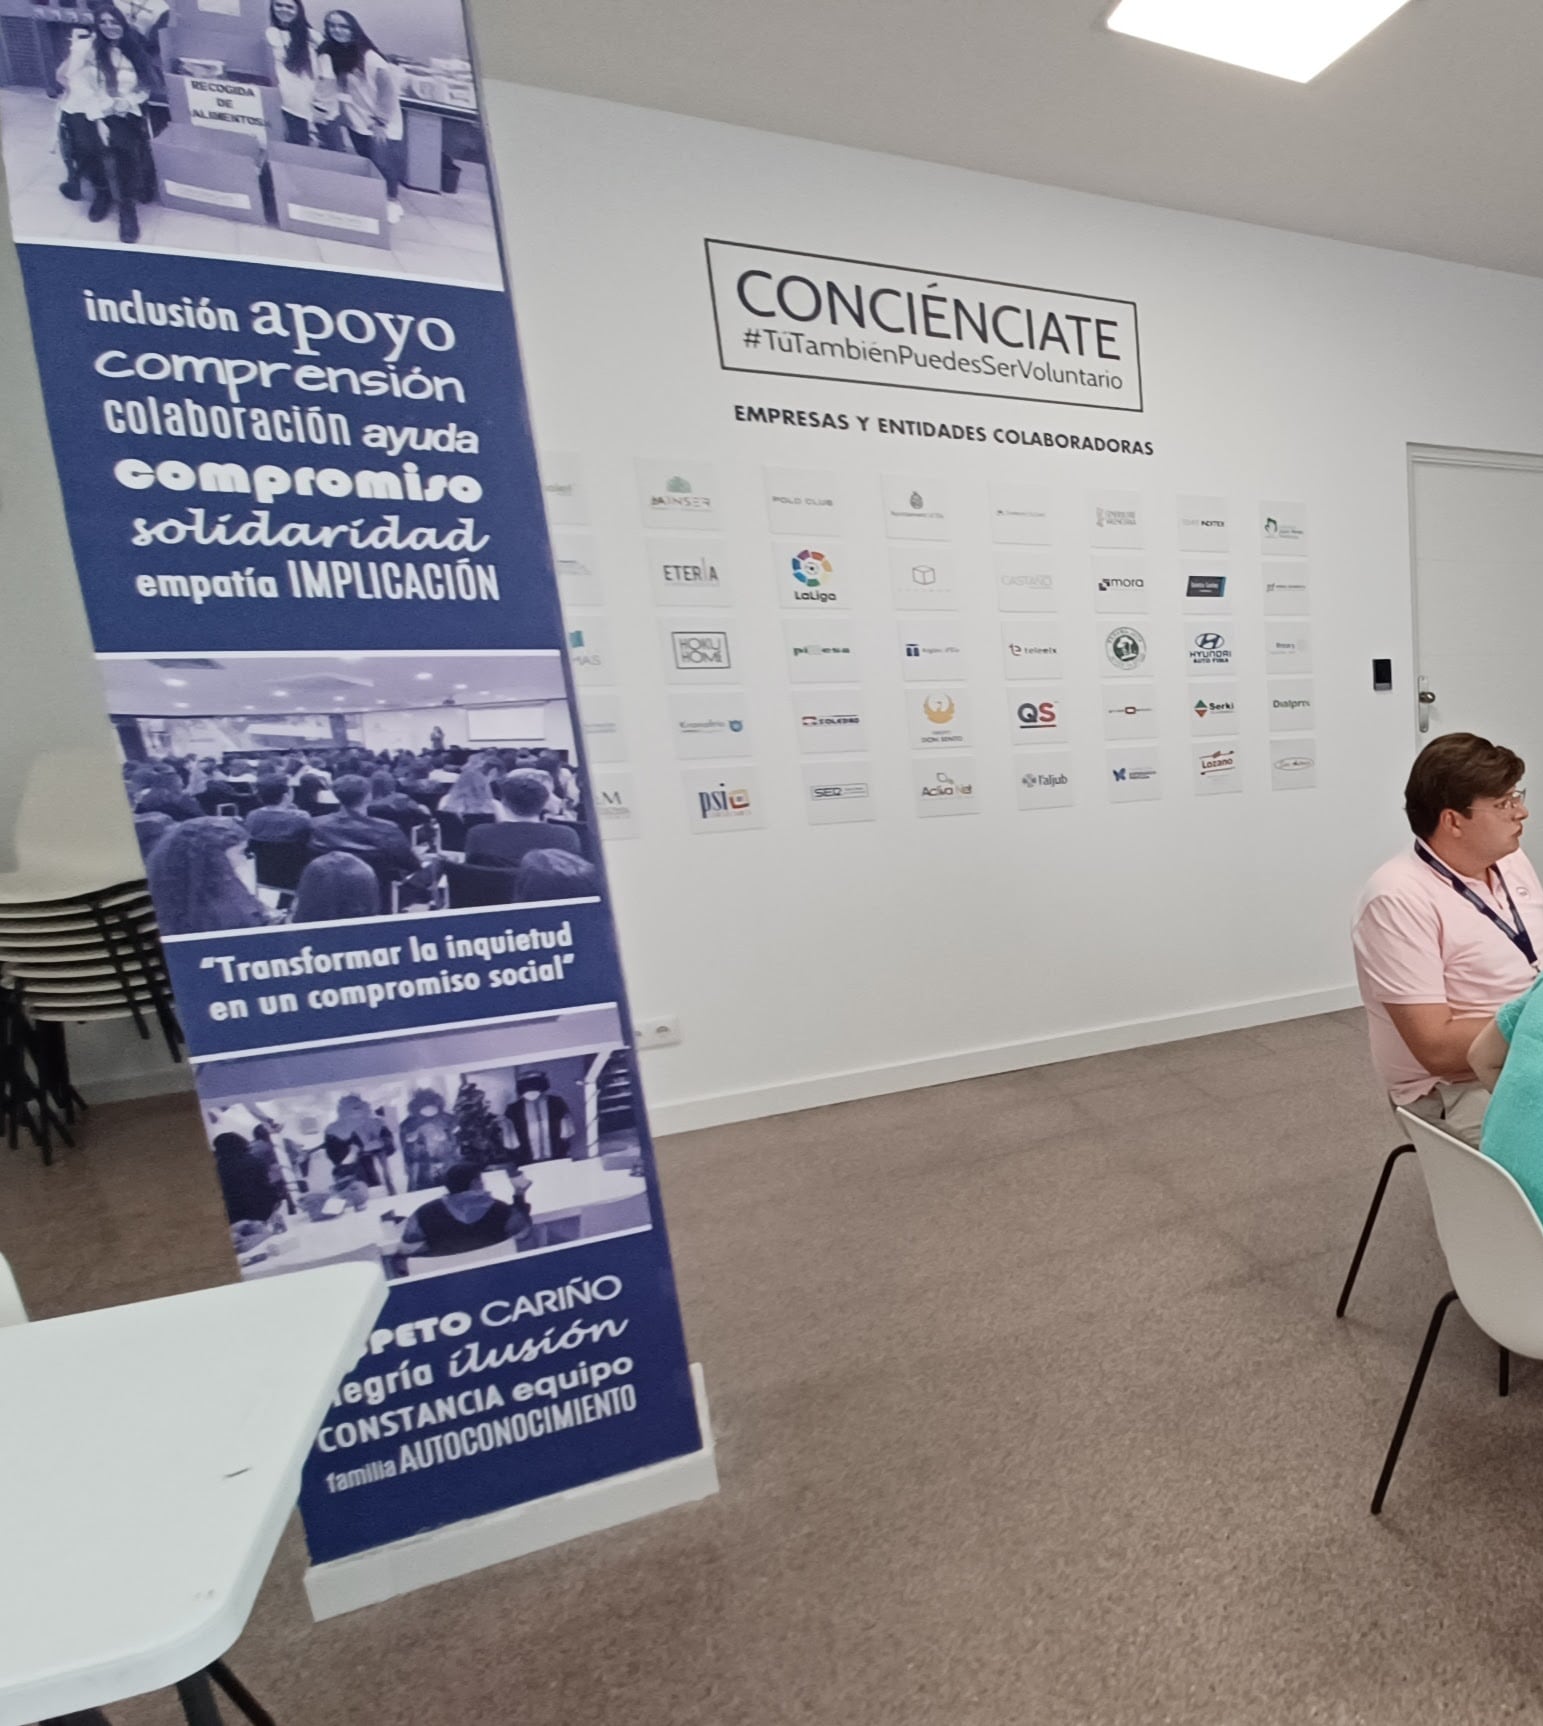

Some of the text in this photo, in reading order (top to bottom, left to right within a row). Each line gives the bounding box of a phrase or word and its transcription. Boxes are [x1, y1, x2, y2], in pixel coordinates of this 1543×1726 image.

[191, 80, 255, 97] RECOGIDA
[216, 98, 234, 109] DE
[83, 290, 456, 363] inclusión apoyo
[736, 269, 1122, 361] CONCIÉNCIATE
[94, 350, 466, 404] comprensión
[103, 398, 480, 457] colaboración ayuda
[734, 405, 1154, 456] EMPRESAS Y ENTIDADES COLABORADORAS
[114, 458, 483, 504] compromiso
[132, 508, 489, 553] solidaridad
[135, 557, 500, 605] empatía IMPLICACIÓN
[794, 590, 837, 603] LaLiga
[1111, 578, 1145, 588] mora
[1017, 702, 1056, 723] QS
[1202, 757, 1233, 769] Lozano
[200, 921, 573, 983] “Transformar la inquietud
[209, 953, 575, 1021] en un compromiso social”
[480, 1275, 622, 1327] CARIÑO
[449, 1318, 629, 1377] ilusión
[317, 1356, 633, 1453] CONSTANCIA equipo
[325, 1383, 637, 1493] familia AUTOCONOCIMIENTO
